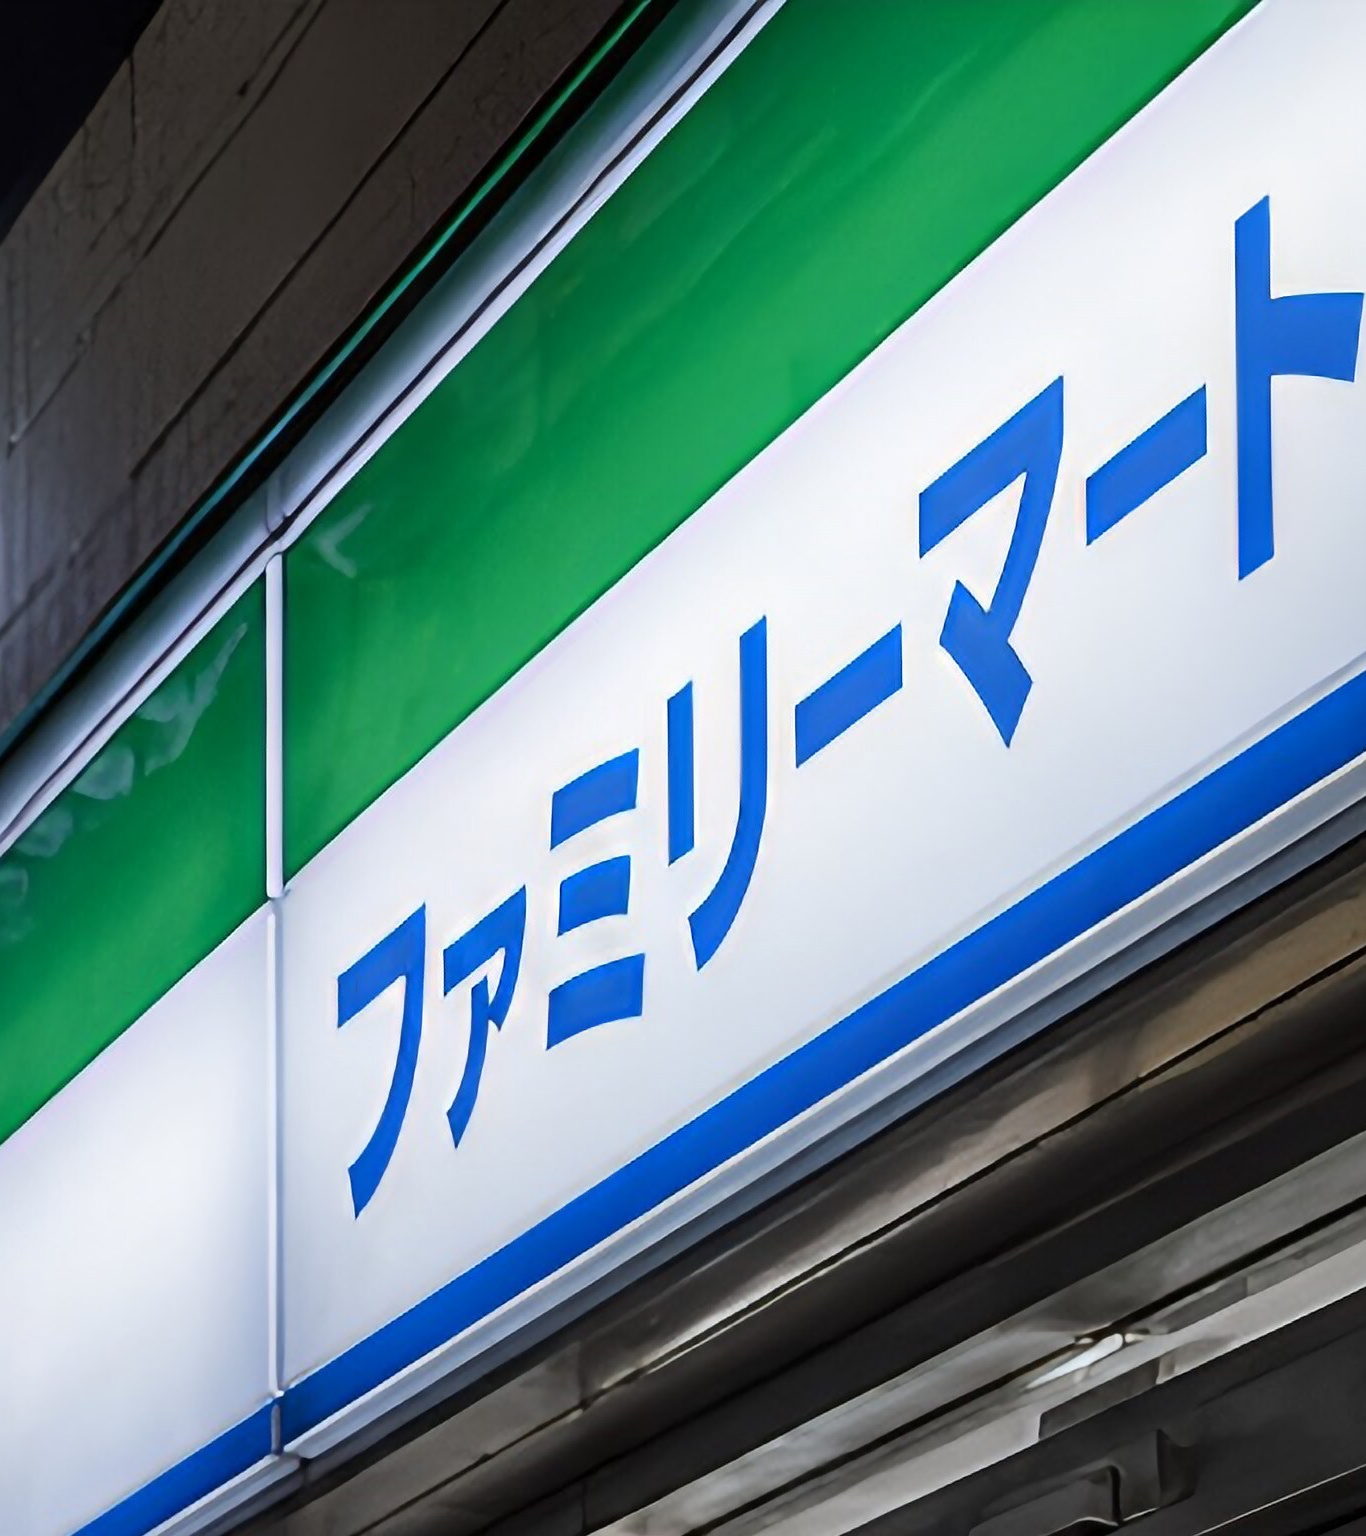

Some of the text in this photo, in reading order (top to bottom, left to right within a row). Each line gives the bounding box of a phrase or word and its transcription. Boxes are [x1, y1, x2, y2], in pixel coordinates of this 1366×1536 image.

[337, 194, 1365, 1220] ファミリーマート
